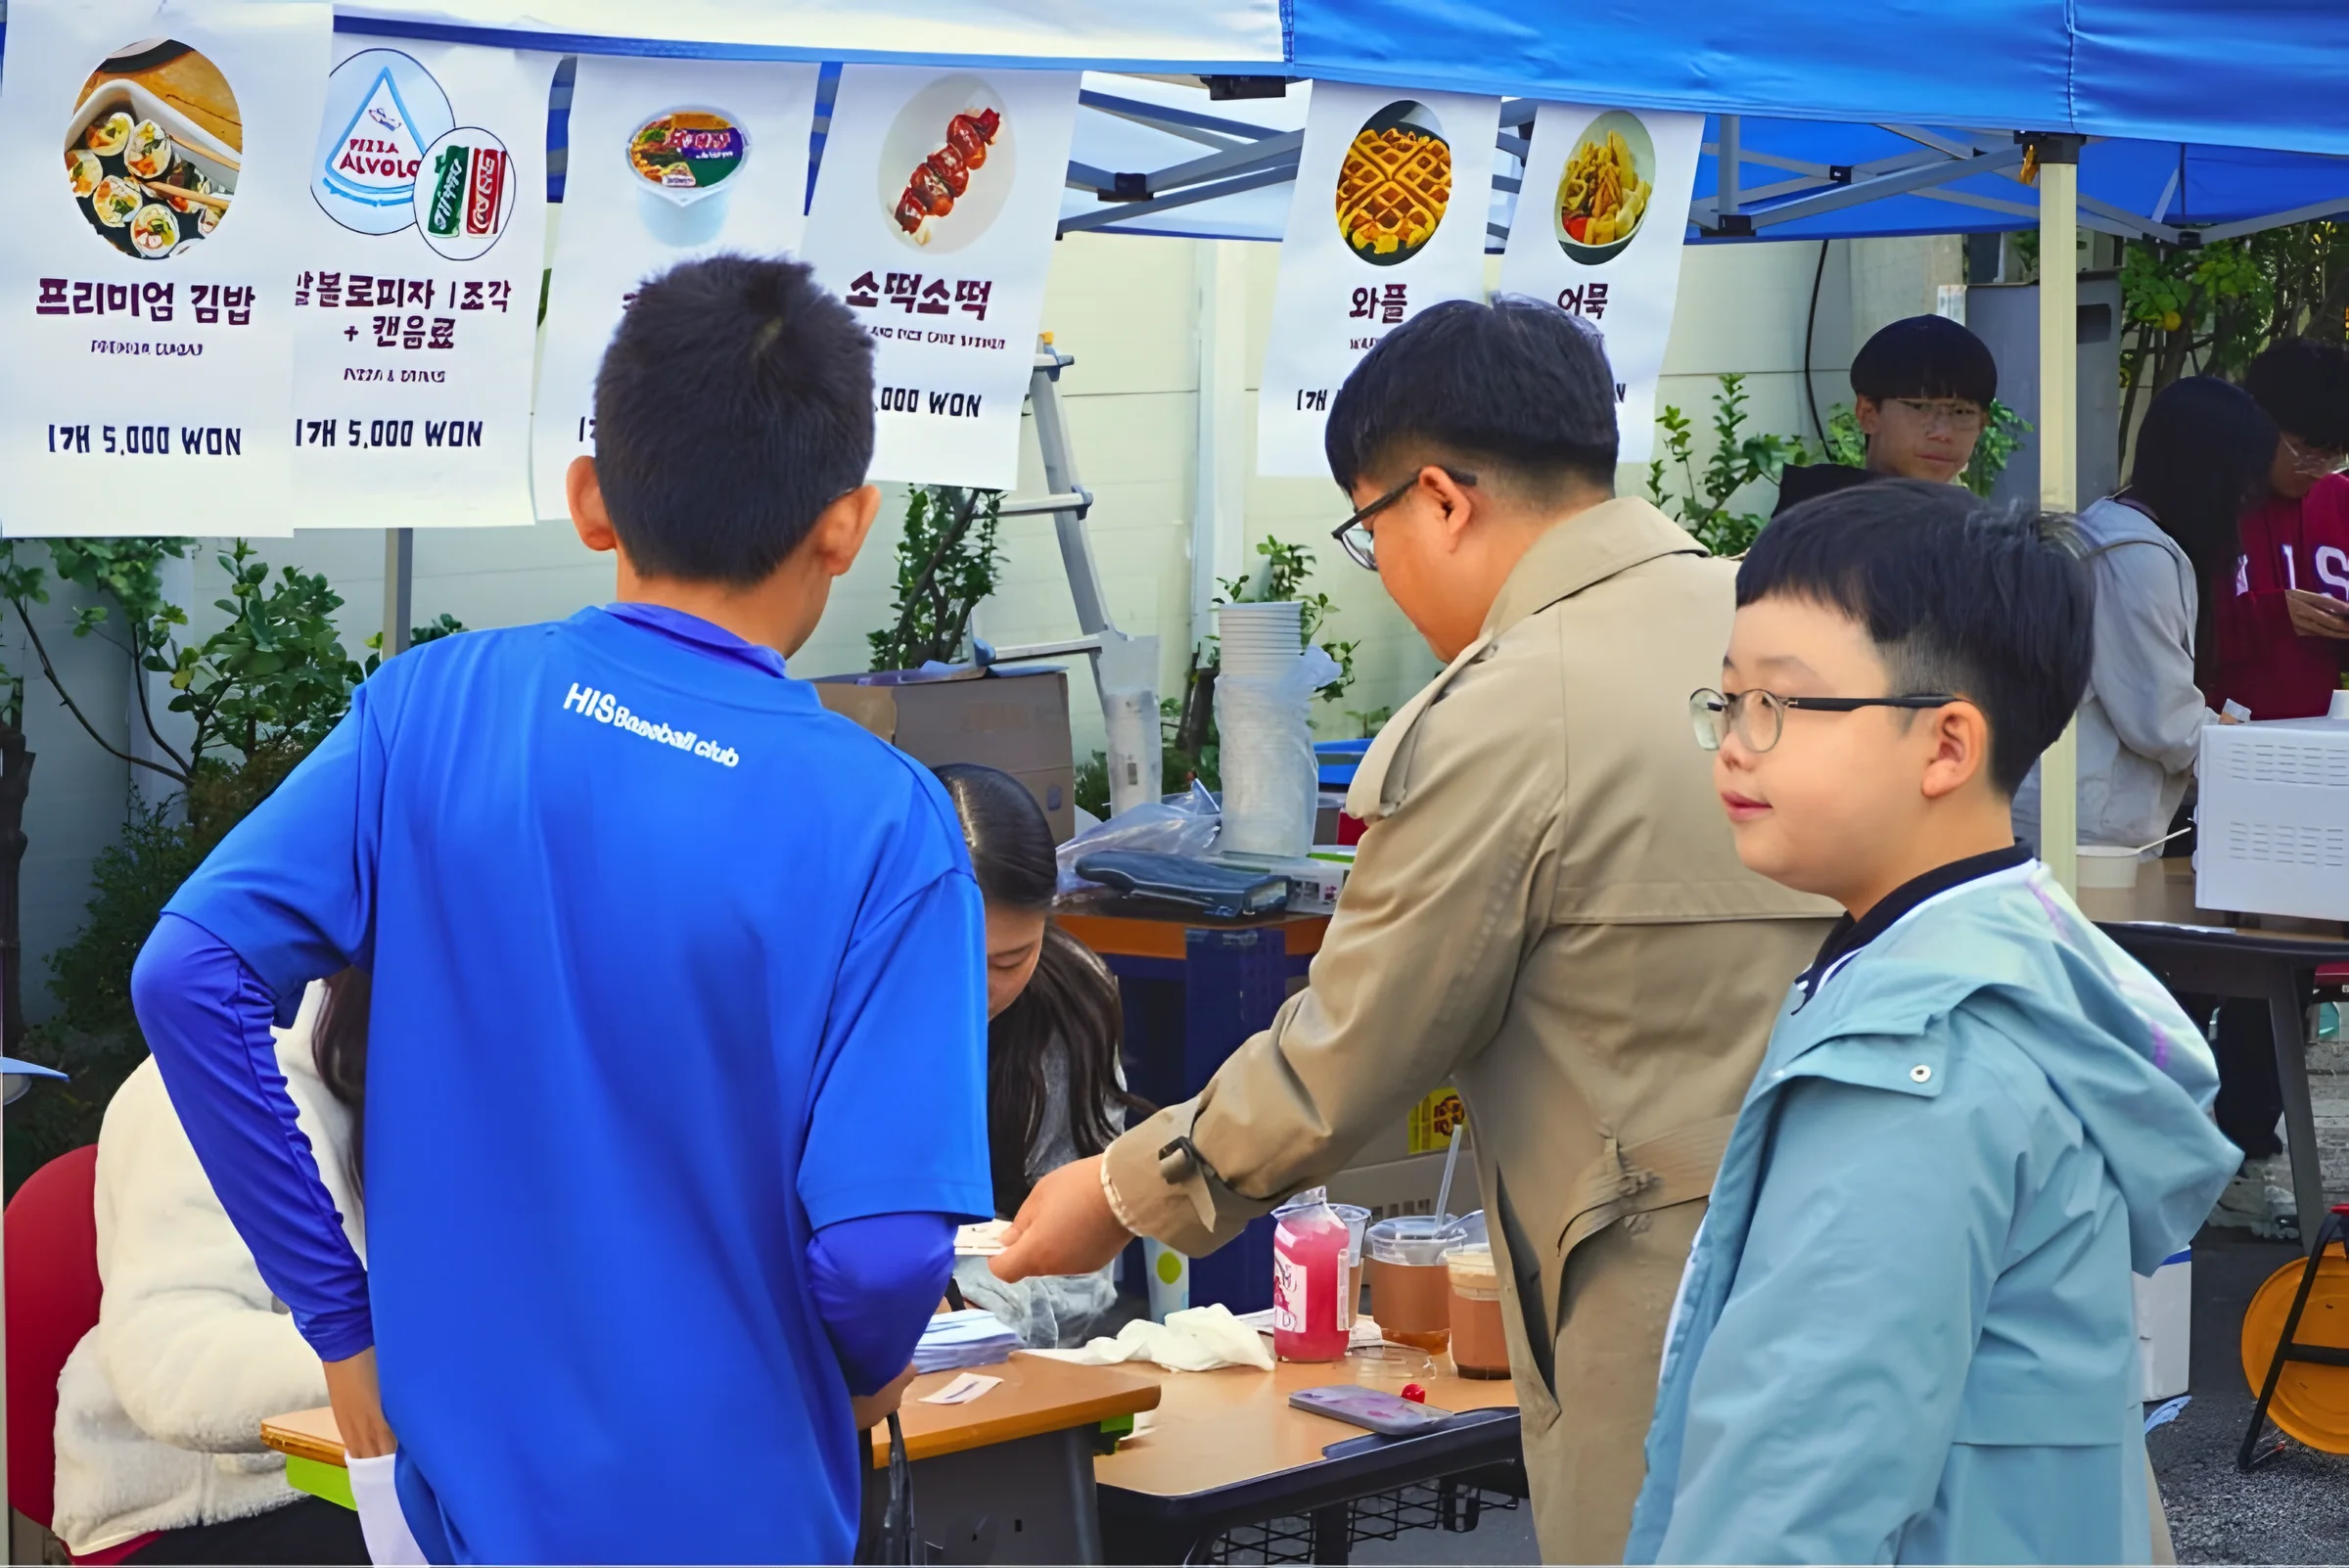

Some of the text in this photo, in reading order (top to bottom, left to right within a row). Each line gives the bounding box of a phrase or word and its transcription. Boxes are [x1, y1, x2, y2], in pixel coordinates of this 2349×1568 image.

[36, 278, 255, 325] 프리미엄 김밥
[846, 271, 992, 321] 소떡소떡
[1349, 284, 1407, 324] 와플
[1557, 283, 1608, 320] 어묵
[373, 315, 456, 349] 캔음료
[929, 391, 982, 418] WON
[1297, 389, 1328, 411] 1개
[48, 424, 242, 456] 1개 5,000 WON
[296, 418, 484, 449] 1개 5,000 WON
[563, 682, 617, 723] HIS
[694, 740, 740, 767] club
